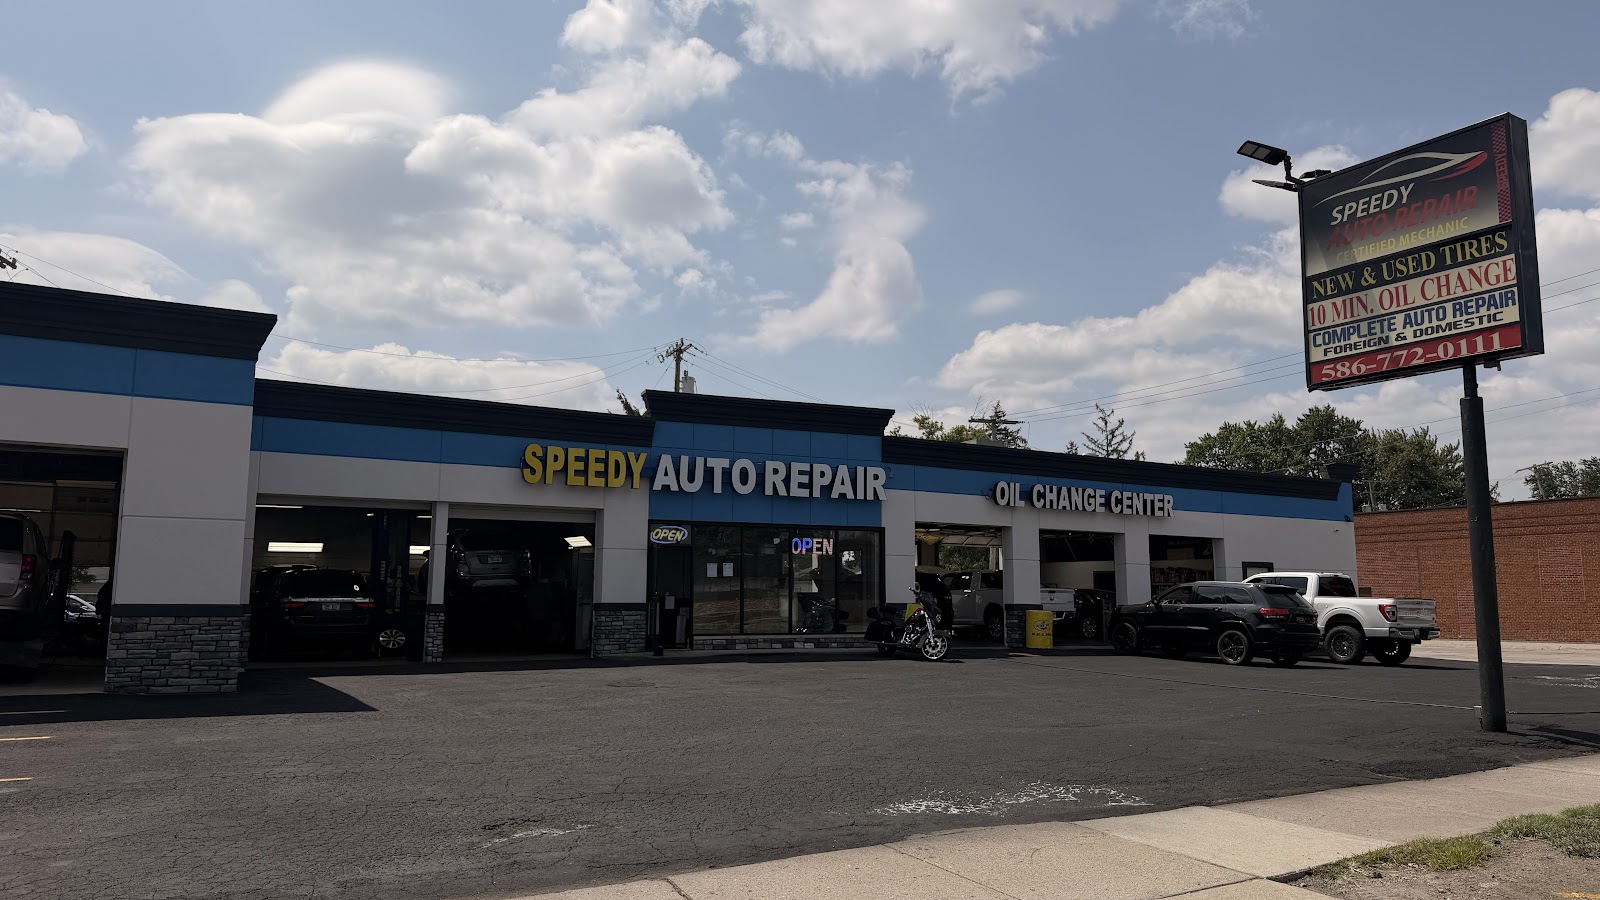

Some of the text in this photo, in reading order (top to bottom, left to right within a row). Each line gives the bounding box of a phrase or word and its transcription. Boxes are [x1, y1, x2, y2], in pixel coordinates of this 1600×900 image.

[1327, 185, 1478, 251] AUTO REPAIR
[1330, 182, 1415, 226] SPEEDY
[1312, 231, 1508, 299] NEW & USED TIRES
[1336, 217, 1469, 264] CERTIFIED MECHANIC
[1308, 257, 1516, 328] 10 MIN. OIL CHANGE
[1312, 289, 1516, 348] COMPLETE AUTO REPAIR
[1323, 311, 1504, 357] FOREIGN & DOMESTIC
[1320, 331, 1504, 382] 586-772-0111
[522, 443, 887, 501] SPEEDY AUTO REPAIR
[994, 480, 1175, 517] OIL CHANGE CENTER
[652, 528, 685, 542] OPEN
[791, 537, 834, 556] OPEN
